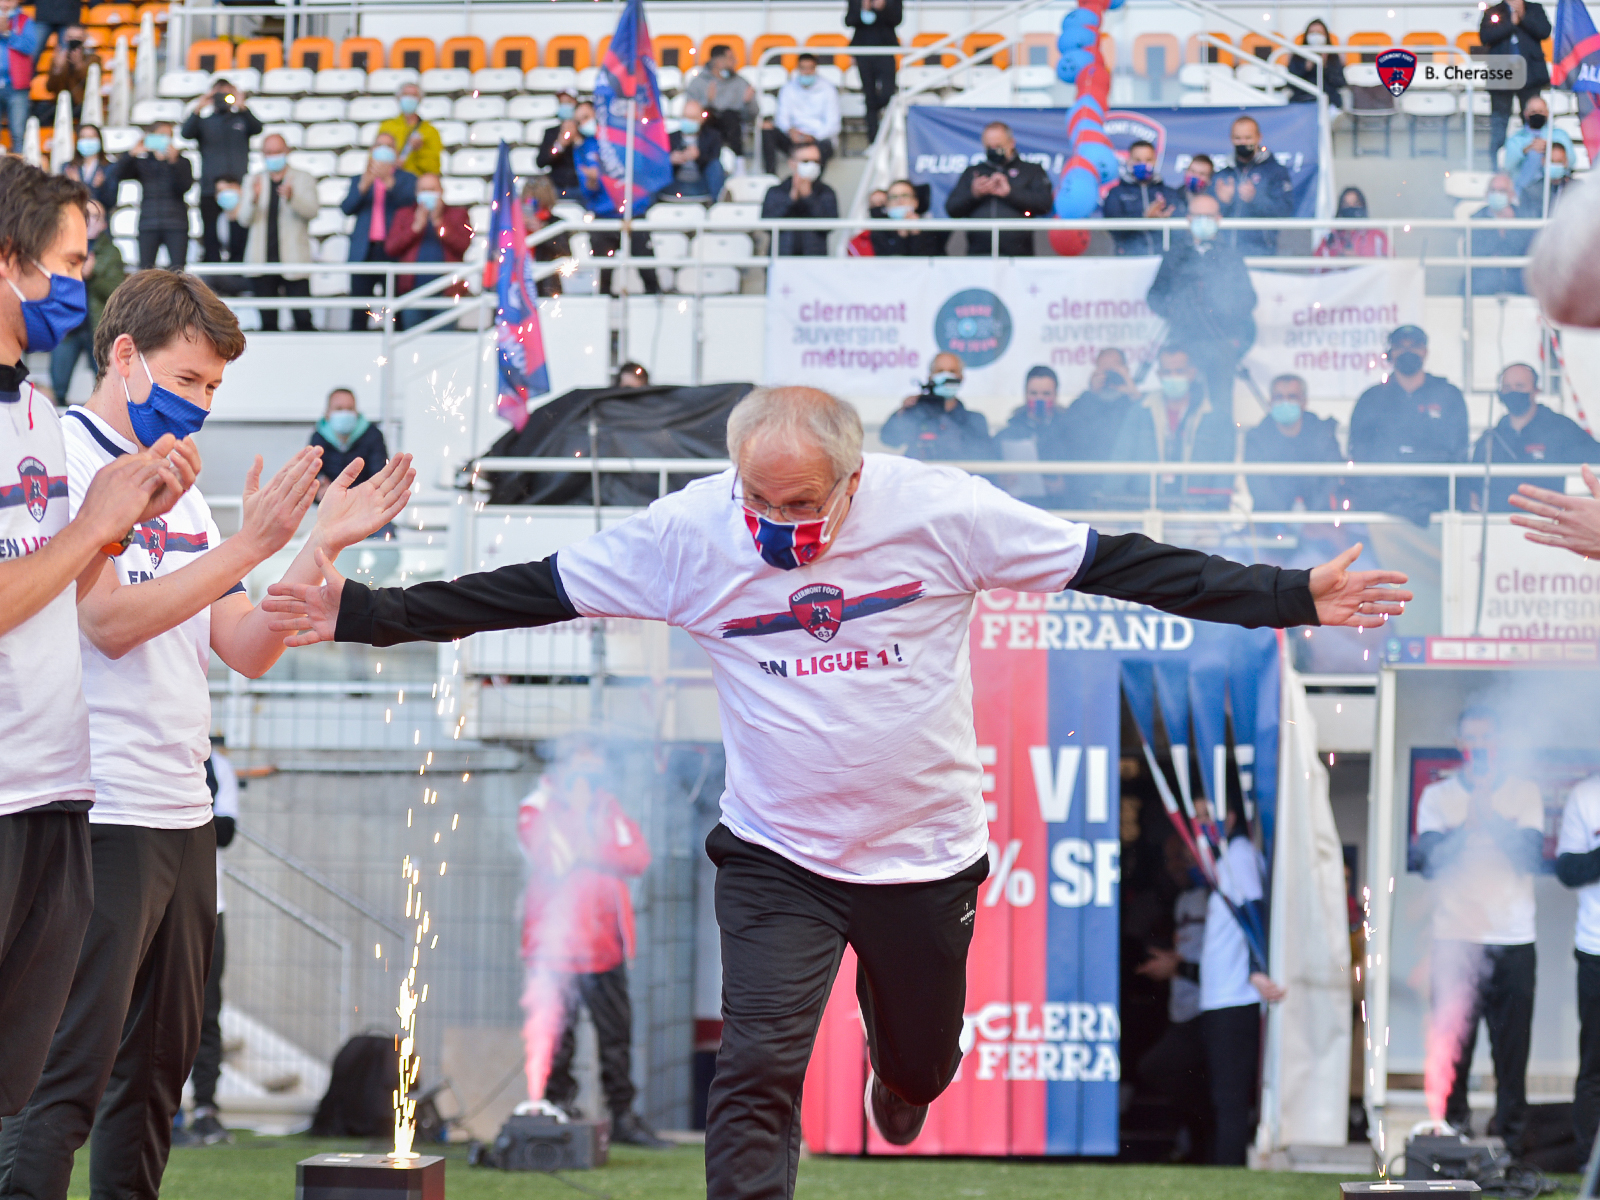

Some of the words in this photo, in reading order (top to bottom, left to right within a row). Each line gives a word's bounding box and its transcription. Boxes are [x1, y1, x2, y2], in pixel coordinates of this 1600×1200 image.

[915, 154, 968, 174] PLUS
[800, 299, 906, 322] clermont
[1048, 296, 1149, 320] clermon
[1293, 303, 1398, 326] clermont
[793, 325, 899, 345] auvergne
[802, 346, 919, 371] métropole
[792, 586, 822, 602] CLERMONT
[822, 585, 840, 597] FOOT
[1488, 597, 1600, 621] auvergn
[818, 630, 831, 638] 63
[979, 613, 1195, 651] FERRAND
[795, 650, 869, 677] LIGUE
[876, 649, 889, 667] 1
[893, 643, 903, 662] !
